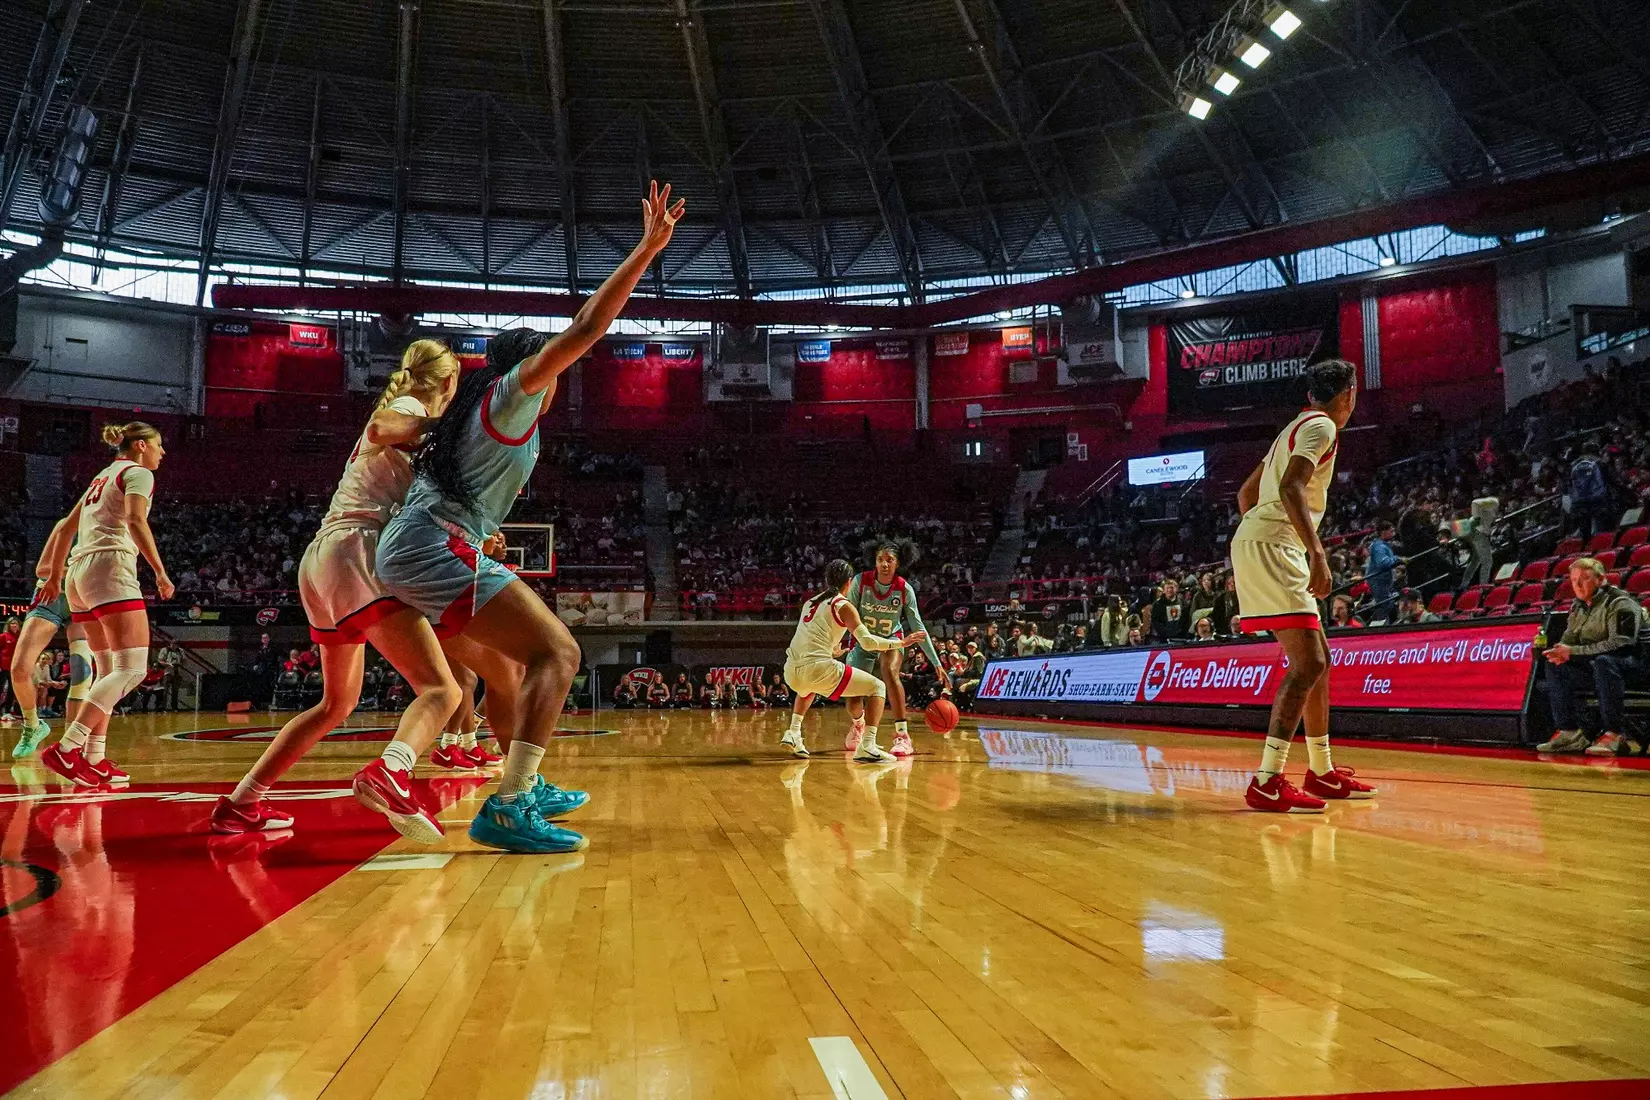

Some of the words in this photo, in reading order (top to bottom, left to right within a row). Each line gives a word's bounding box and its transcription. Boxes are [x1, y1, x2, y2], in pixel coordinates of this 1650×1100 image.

[299, 331, 318, 339] WKU
[462, 342, 475, 350] FIU
[664, 348, 695, 356] LIBERTY
[1225, 363, 1267, 383] CLIMB
[1271, 358, 1307, 379] HERE
[1145, 465, 1188, 474] CANDLEWOOD
[85, 476, 109, 507] 23
[803, 600, 821, 623] 3
[985, 604, 1025, 612] LEACHAN
[863, 615, 892, 637] 23
[1344, 651, 1360, 666] or
[1360, 649, 1397, 665] more
[1399, 643, 1428, 665] and
[1431, 640, 1468, 663] we'll
[1470, 638, 1531, 661] deliver
[710, 667, 764, 687] WKU
[980, 665, 1009, 697] ACE
[1003, 668, 1072, 698] REWARDS
[1167, 662, 1202, 689] Free
[1202, 658, 1273, 696] Delivery
[1362, 673, 1393, 694] free.
